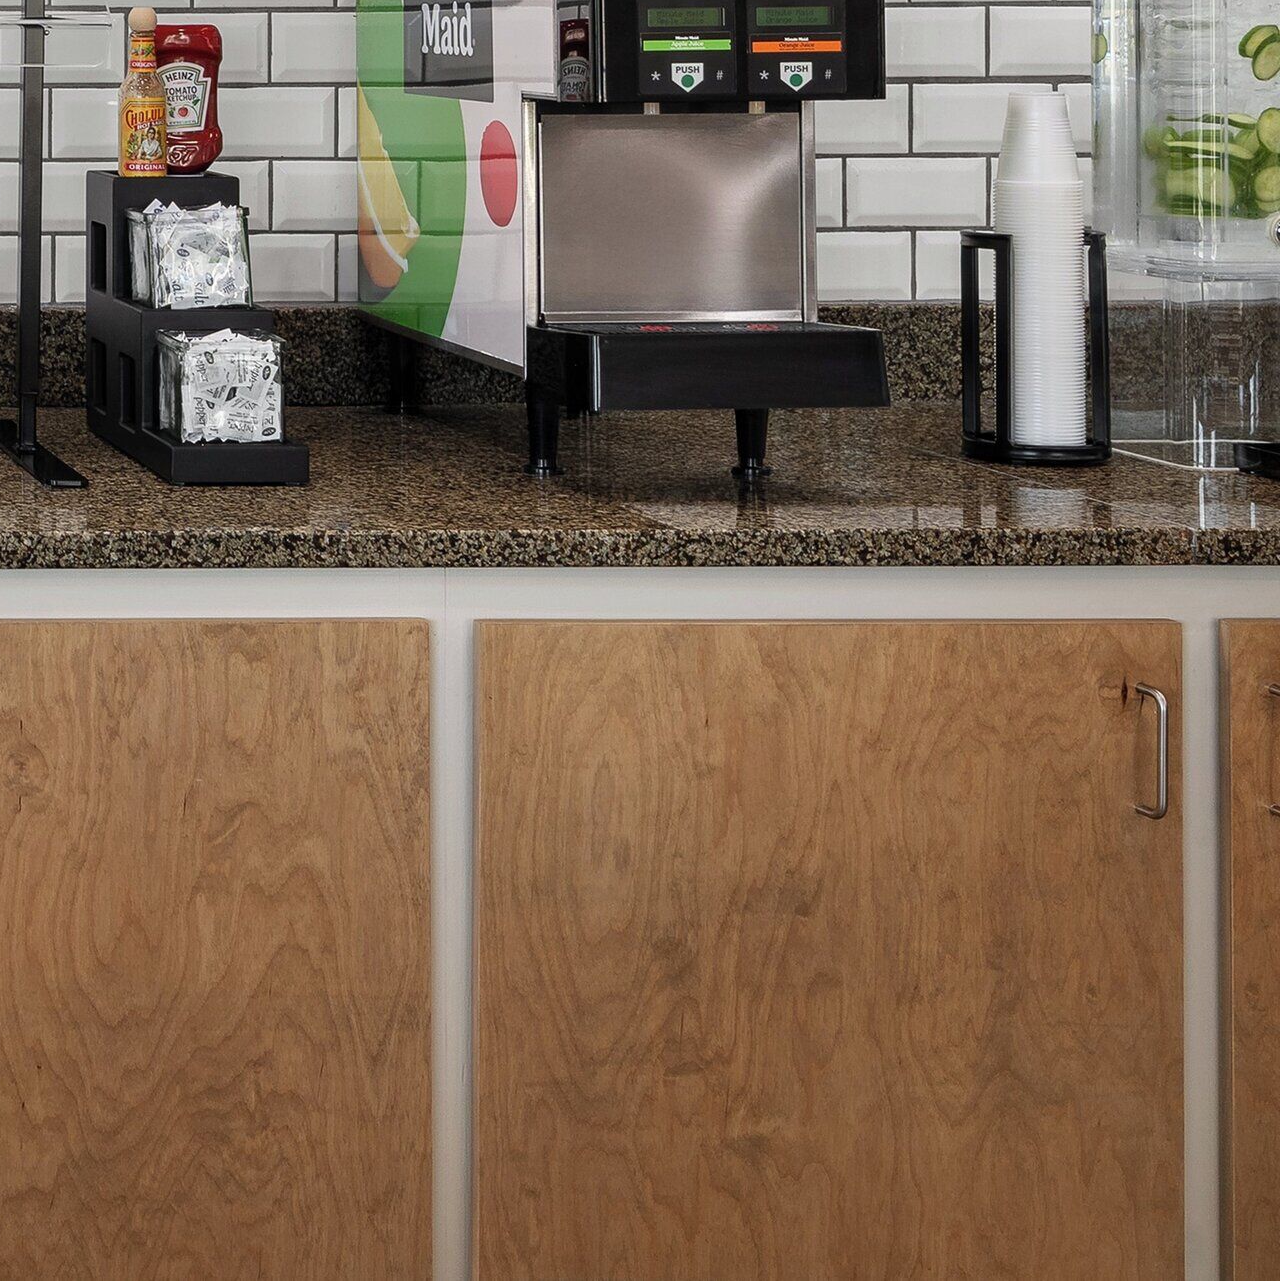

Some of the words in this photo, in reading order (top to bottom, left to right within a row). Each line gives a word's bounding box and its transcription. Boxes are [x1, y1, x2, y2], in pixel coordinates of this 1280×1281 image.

[421, 1, 474, 56] Maid
[675, 66, 700, 74] PUSH
[784, 65, 809, 73] PUSH
[165, 72, 194, 83] HEINZ
[165, 86, 197, 96] TOMATO
[167, 94, 197, 102] KETCHUP
